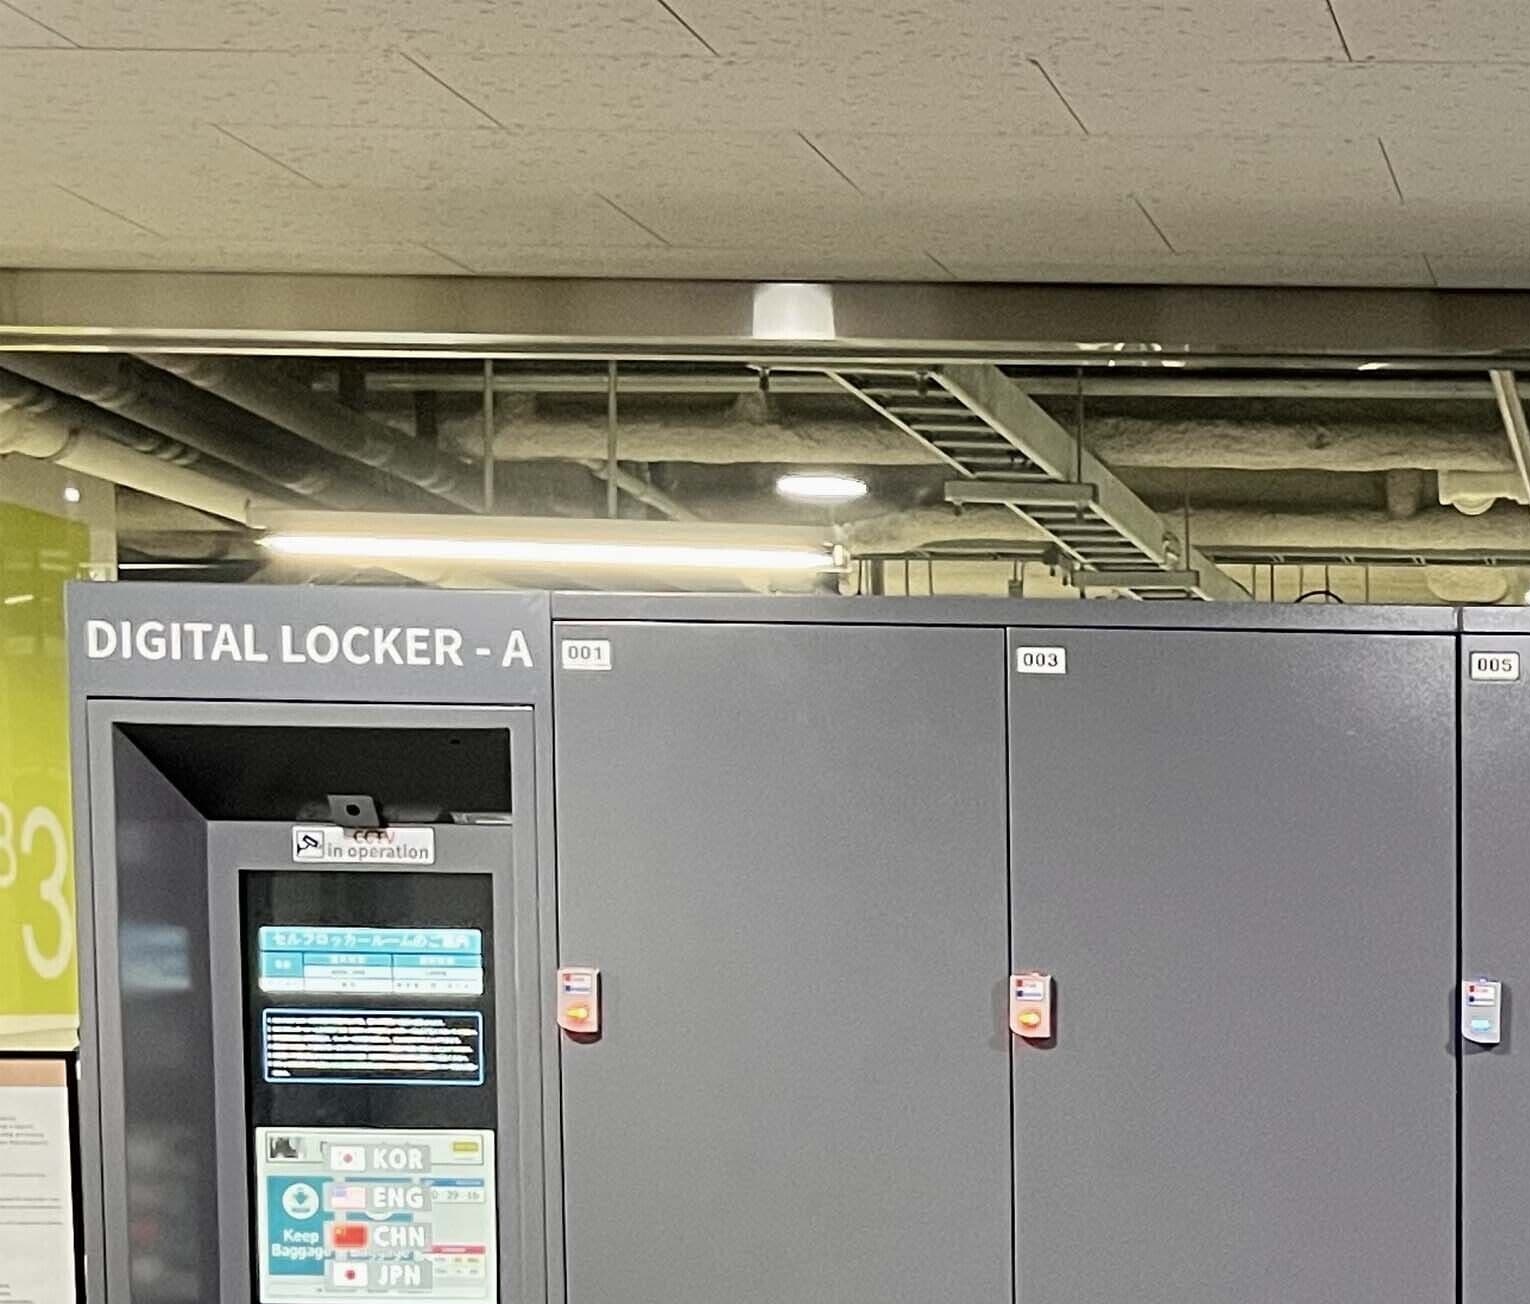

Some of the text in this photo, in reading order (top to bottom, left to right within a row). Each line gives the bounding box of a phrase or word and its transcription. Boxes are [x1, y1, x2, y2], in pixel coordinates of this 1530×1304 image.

[87, 619, 534, 668] DIGITAL LOCKER - A
[567, 645, 602, 660] 001
[1024, 652, 1058, 668] 003
[1477, 658, 1513, 672] 005
[352, 829, 397, 844] CCTV
[328, 843, 430, 861] in operation
[373, 1147, 424, 1170] KOR
[373, 1187, 425, 1208] ENG
[283, 1229, 320, 1244] Keep
[373, 1225, 426, 1248] CHN
[377, 1265, 422, 1286] JPN
